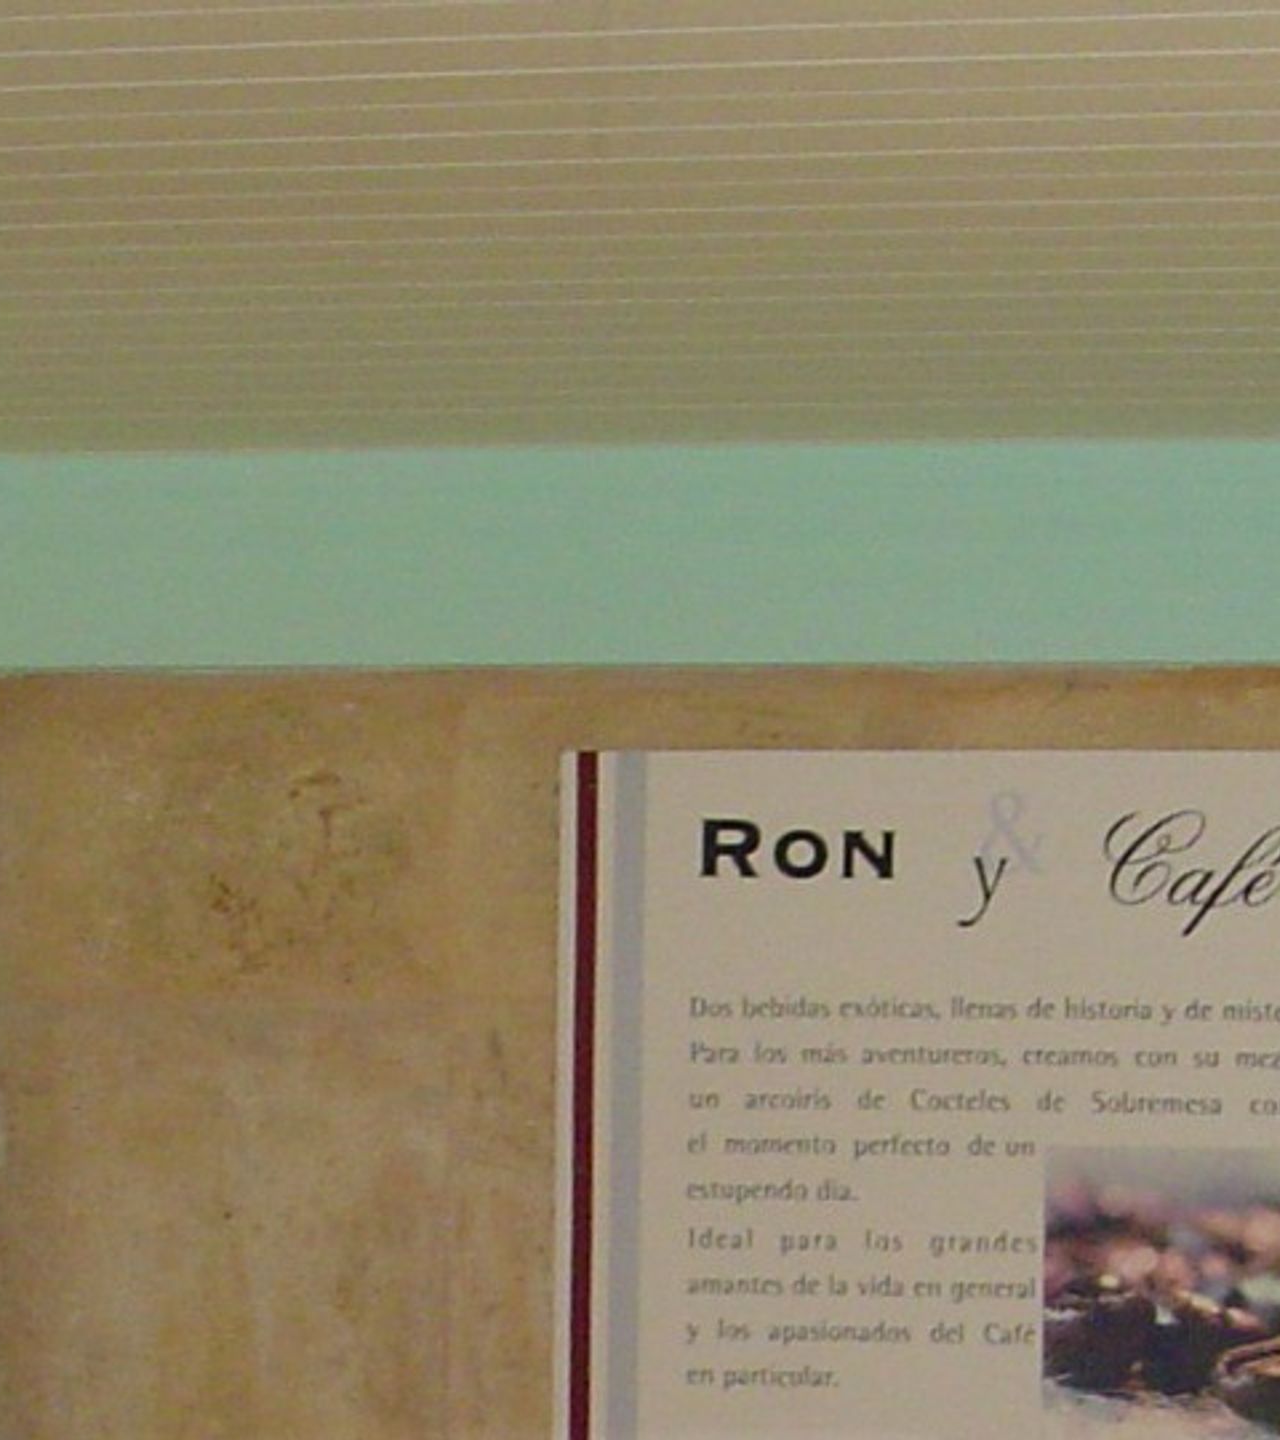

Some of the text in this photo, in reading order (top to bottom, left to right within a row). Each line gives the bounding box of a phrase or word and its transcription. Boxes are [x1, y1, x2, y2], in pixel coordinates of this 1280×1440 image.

[956, 855, 1008, 928] y
[689, 996, 734, 1019] Dos
[741, 996, 832, 1020] bebidas
[950, 996, 1019, 1020] llenas
[1025, 996, 1056, 1020] de
[1064, 996, 1154, 1021] historia
[1160, 1004, 1176, 1027] y
[1183, 998, 1214, 1022] de
[689, 1041, 740, 1065] Para
[753, 1042, 788, 1065] los
[800, 1043, 849, 1065] más
[1021, 1048, 1120, 1068] creamos
[1133, 1050, 1178, 1069] con
[1192, 1051, 1221, 1069] su
[688, 1092, 720, 1110] un
[856, 1089, 886, 1111] de
[909, 1088, 1012, 1113] Cocteles
[1036, 1089, 1066, 1114] de
[1092, 1090, 1222, 1115] Sobremesa
[686, 1132, 1036, 1160] el momento perfecto de un
[686, 1180, 808, 1205] estupendo
[688, 1227, 1036, 1258] Ideal para los grandes
[686, 1273, 1035, 1304] amantes de la vida en general
[685, 1323, 699, 1345] y
[717, 1318, 752, 1341] los
[767, 1321, 912, 1346] apasionados
[928, 1319, 965, 1344] del
[685, 1366, 838, 1390] en particular.
